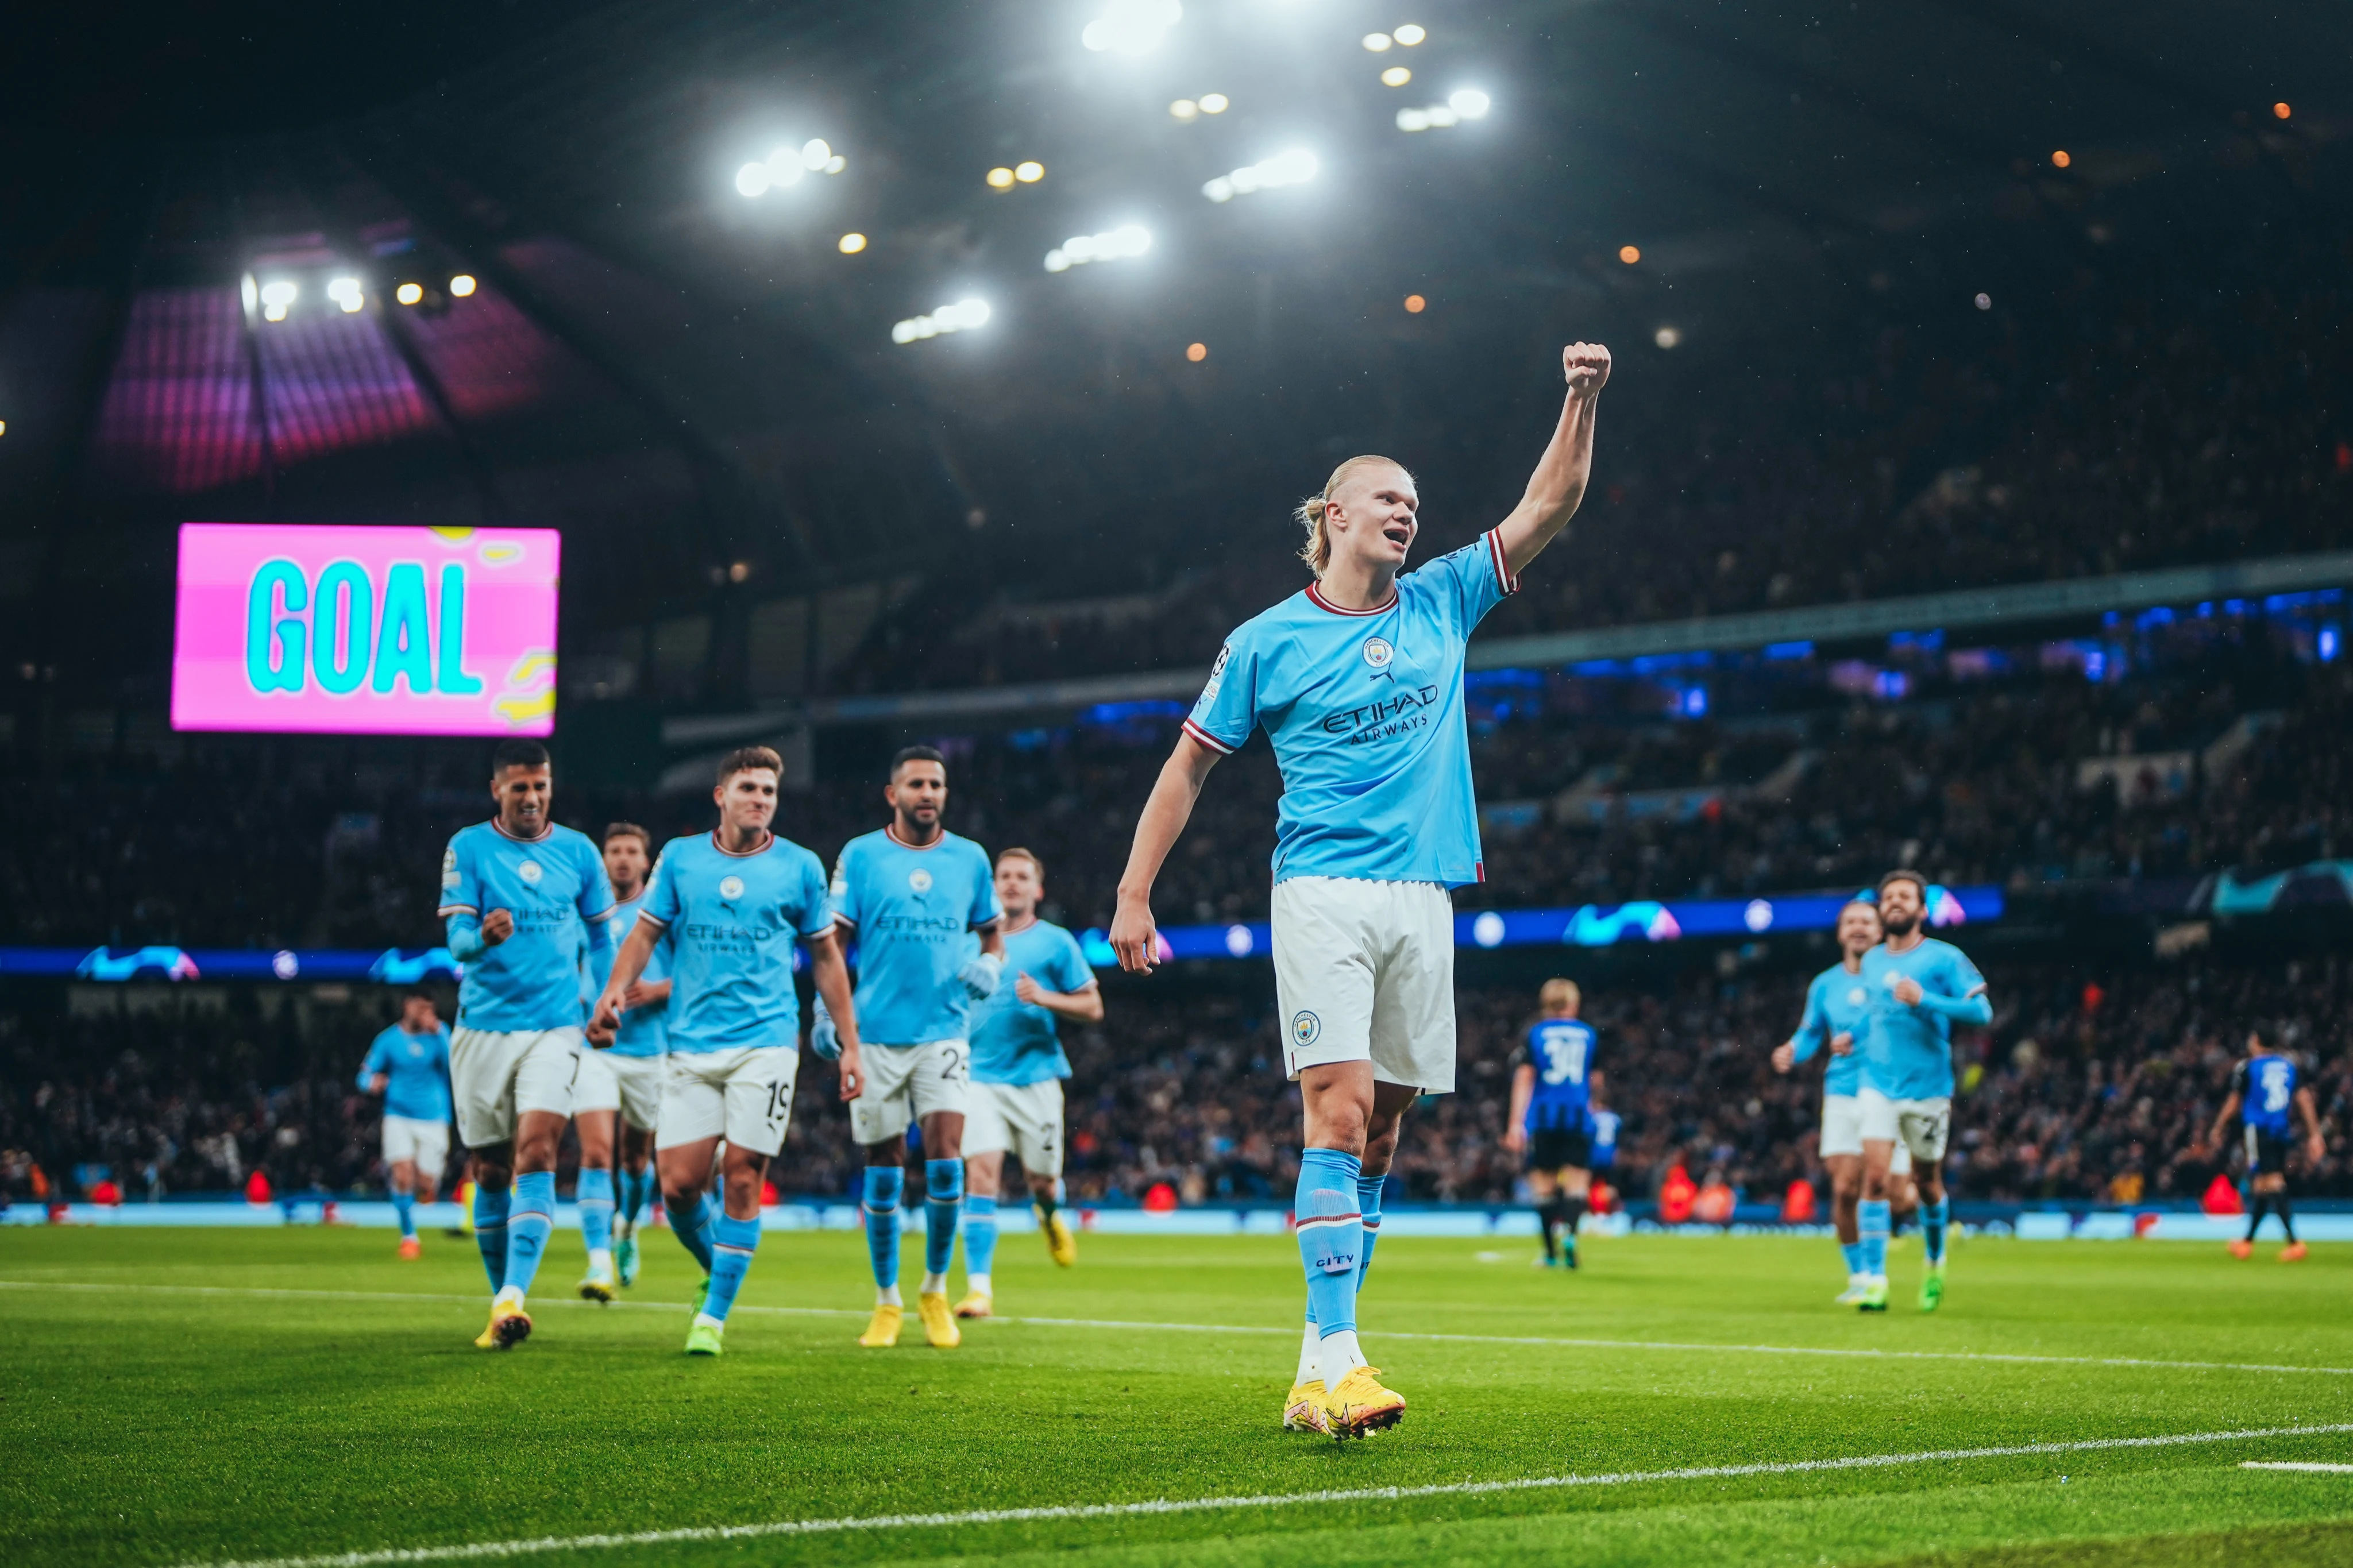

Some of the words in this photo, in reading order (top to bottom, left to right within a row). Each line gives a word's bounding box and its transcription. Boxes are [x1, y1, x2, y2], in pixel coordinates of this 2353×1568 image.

[248, 559, 482, 695] GOAL
[1365, 639, 1390, 650] MANCHESTER
[1324, 685, 1438, 733] ETIHAD
[1351, 713, 1427, 745] AIRWAYS
[876, 916, 959, 930] ETIHAD
[687, 924, 771, 940] ETIHAD
[1294, 1013, 1316, 1027] MANCHESTER
[767, 1080, 789, 1121] 19
[1316, 1254, 1353, 1267] CITY
